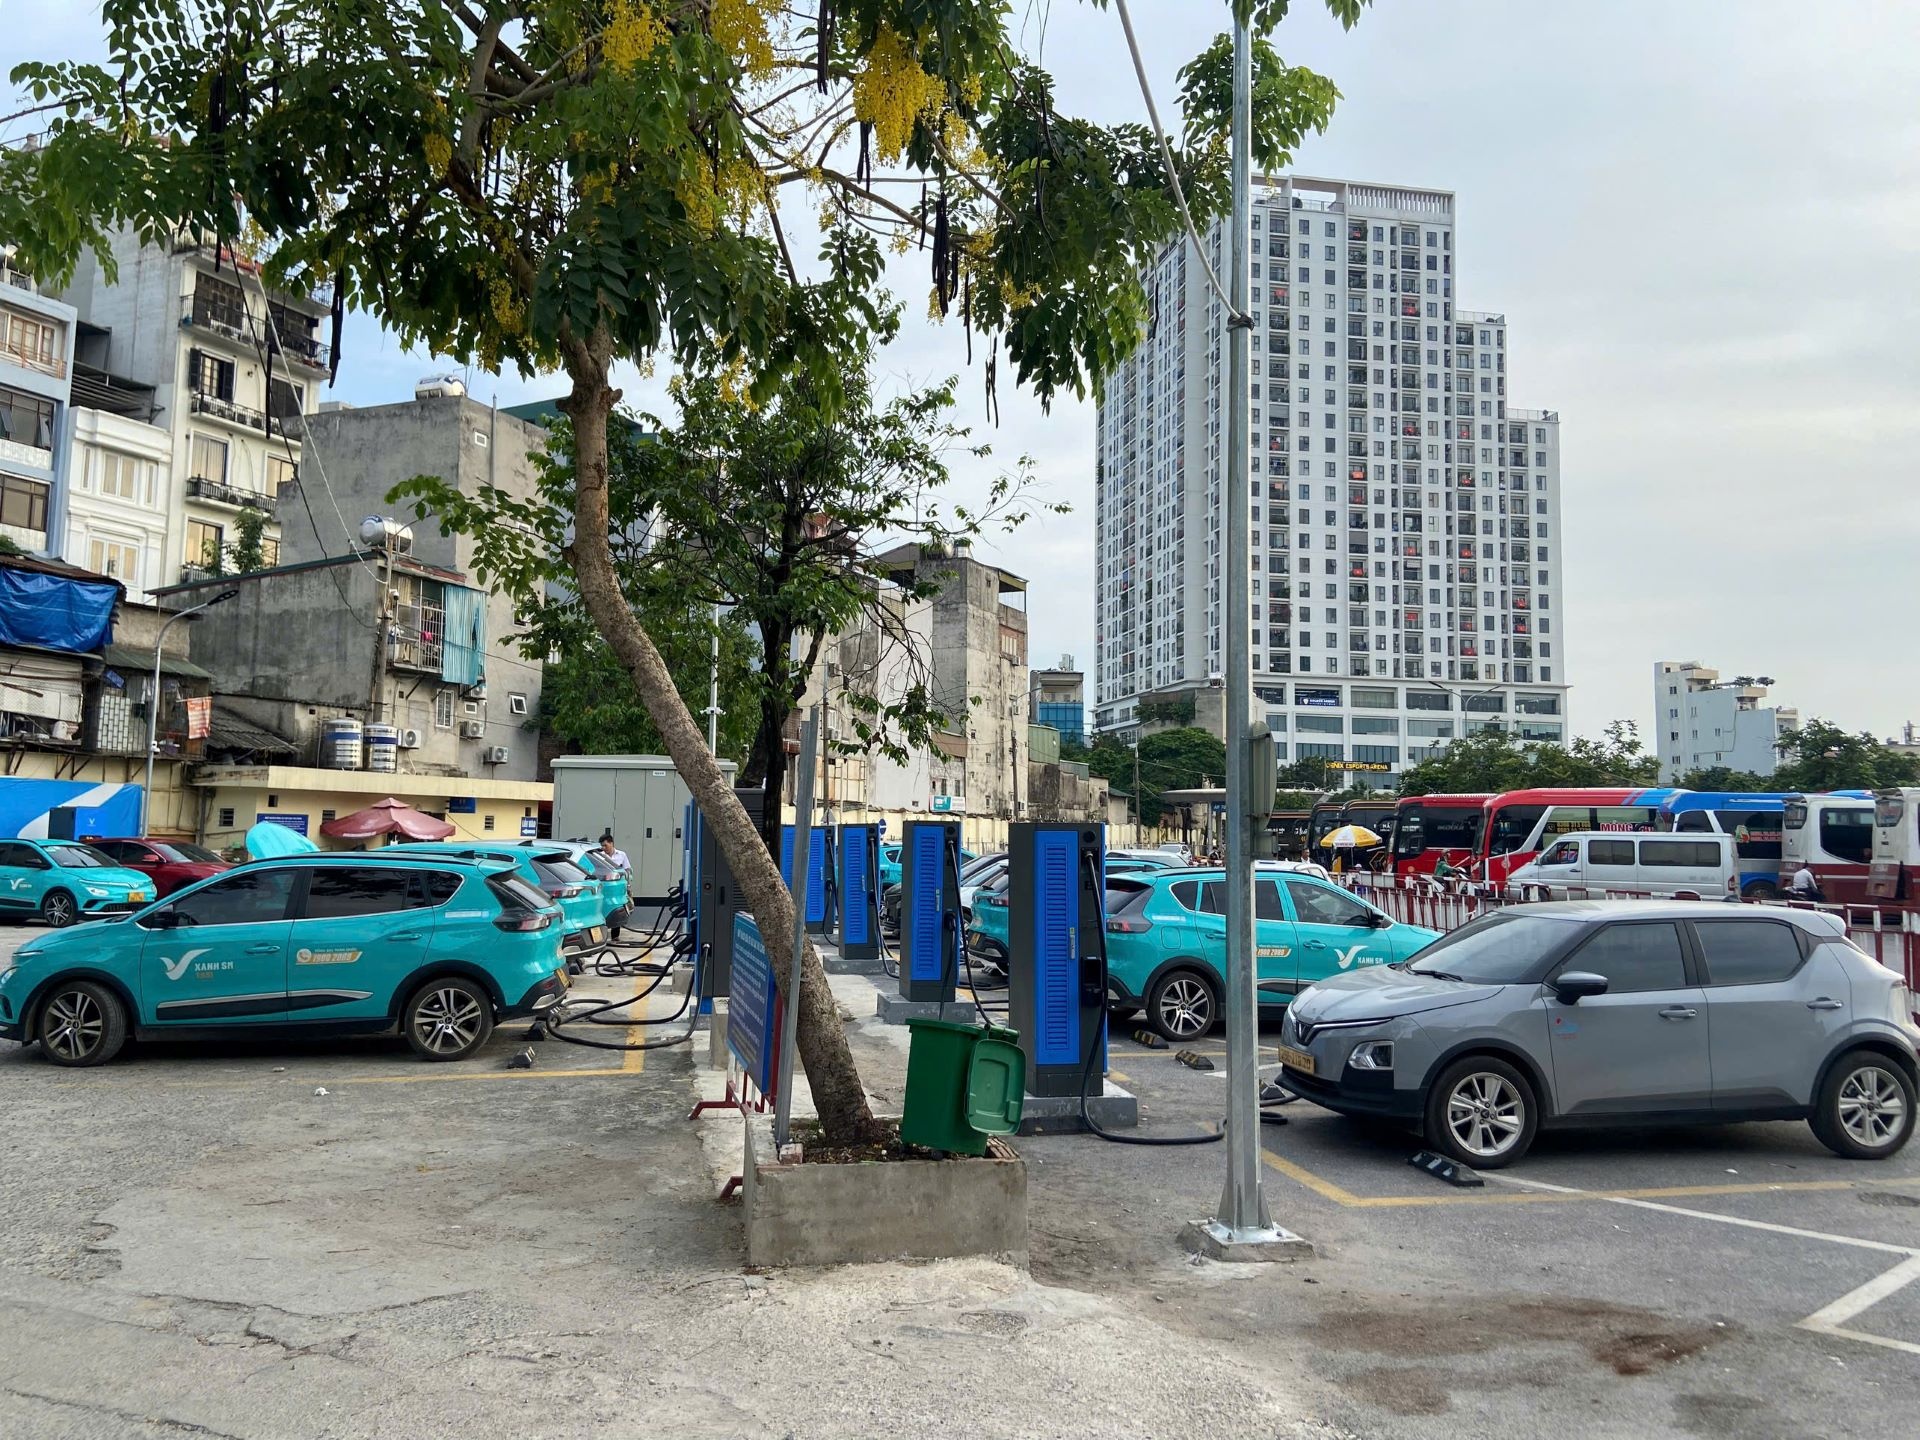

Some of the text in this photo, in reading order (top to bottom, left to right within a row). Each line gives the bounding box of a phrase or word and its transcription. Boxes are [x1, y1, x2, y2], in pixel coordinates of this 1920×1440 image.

[1357, 956, 1384, 965] XANH SM
[194, 961, 234, 971] XANH SM
